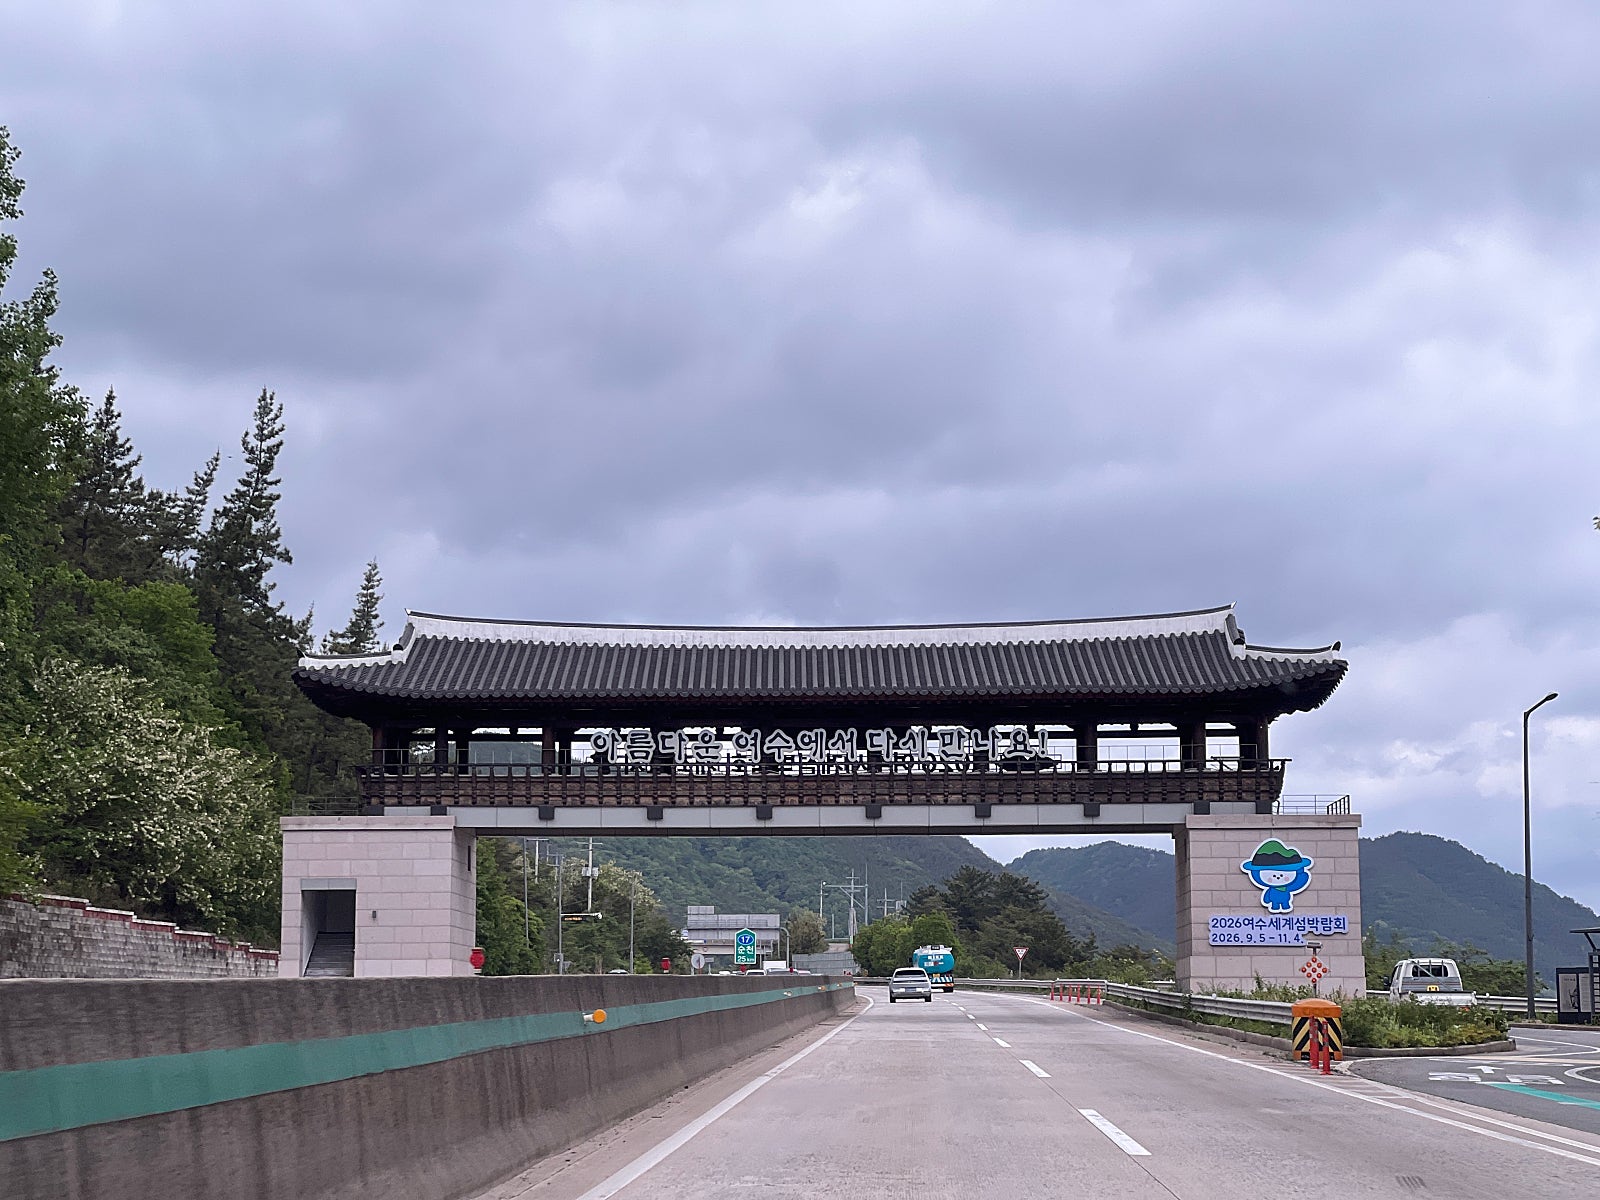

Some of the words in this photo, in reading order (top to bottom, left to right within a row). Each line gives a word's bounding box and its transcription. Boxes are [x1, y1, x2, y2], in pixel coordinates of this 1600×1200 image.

[590, 729, 723, 764] 아름다운
[732, 728, 857, 763] 여수에서
[865, 727, 928, 762] 다시
[937, 727, 1047, 762] 만나요!
[1211, 917, 1346, 931] 2026여수세계섬박람회
[737, 945, 754, 955] 순천
